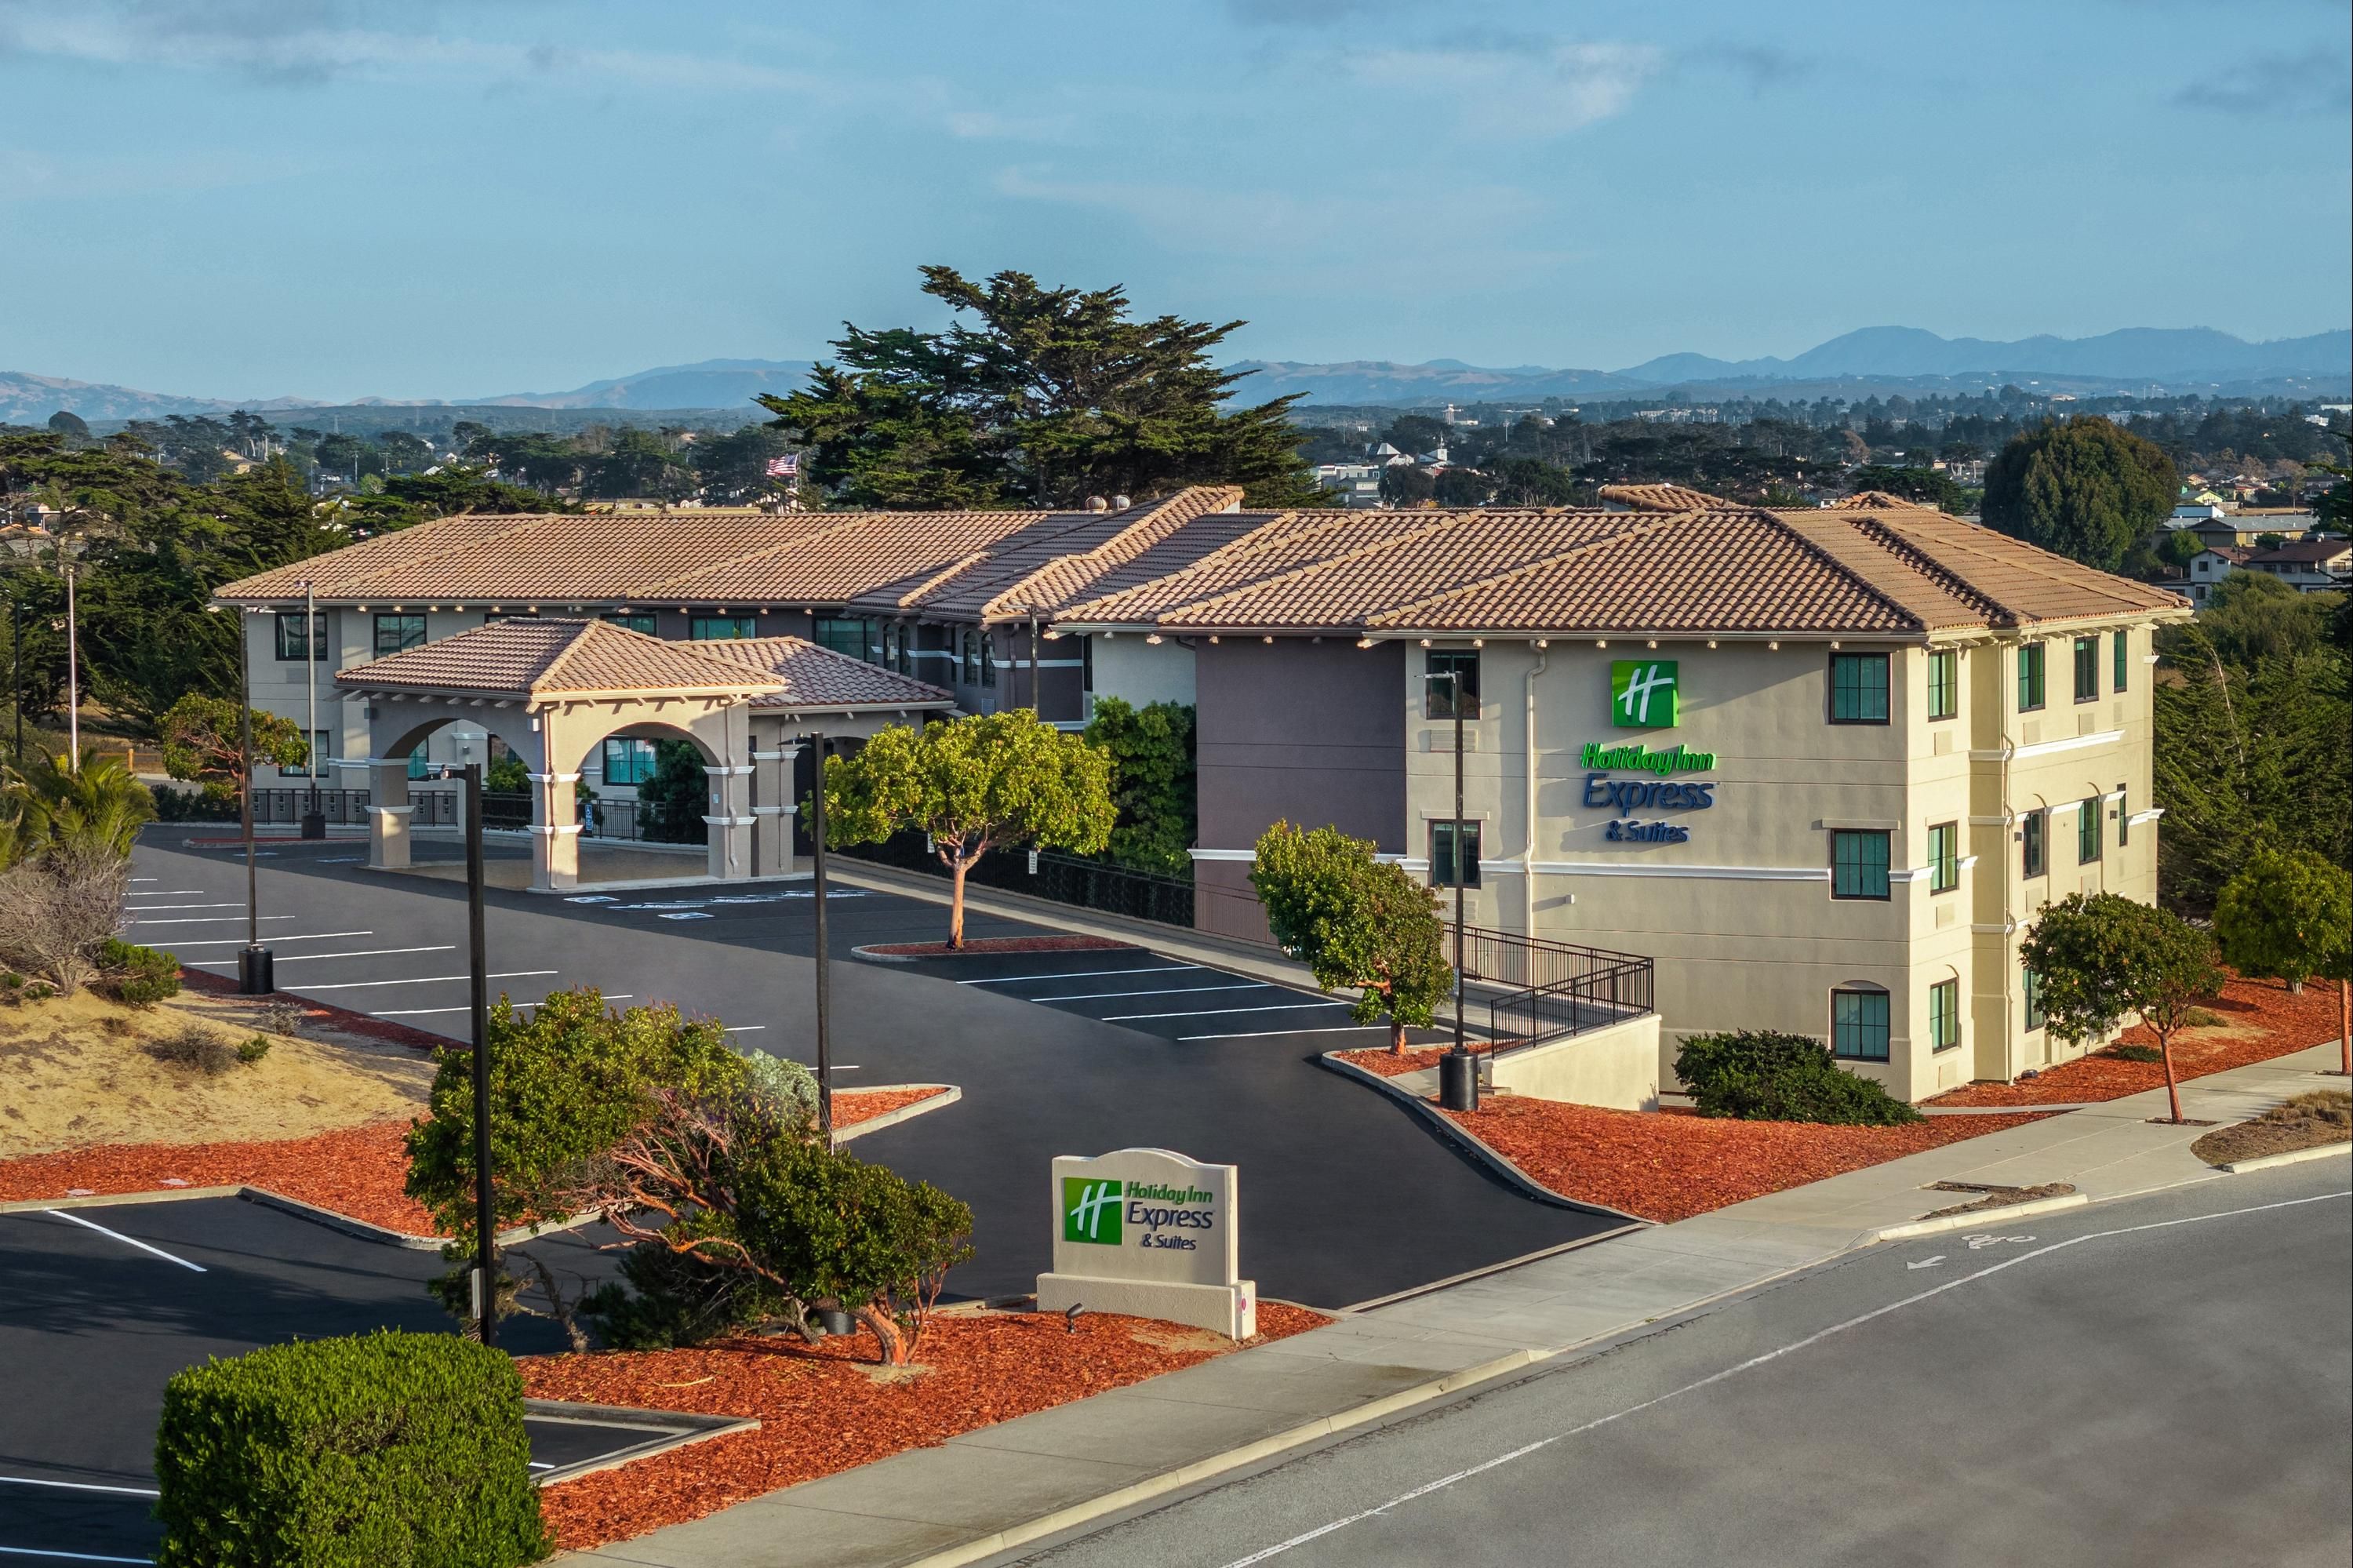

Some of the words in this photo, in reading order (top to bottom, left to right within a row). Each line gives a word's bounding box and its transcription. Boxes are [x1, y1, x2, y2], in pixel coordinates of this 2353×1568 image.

[1581, 743, 1674, 775] Holiday
[1675, 744, 1716, 770] Inn
[1583, 773, 1715, 817] Express
[1606, 820, 1623, 842] &
[1625, 820, 1689, 842] Suites
[1125, 1181, 1186, 1205] Holiday
[1187, 1185, 1213, 1202] Inn
[1128, 1201, 1213, 1231] Express
[1142, 1233, 1152, 1247] &
[1155, 1234, 1197, 1250] Suites
